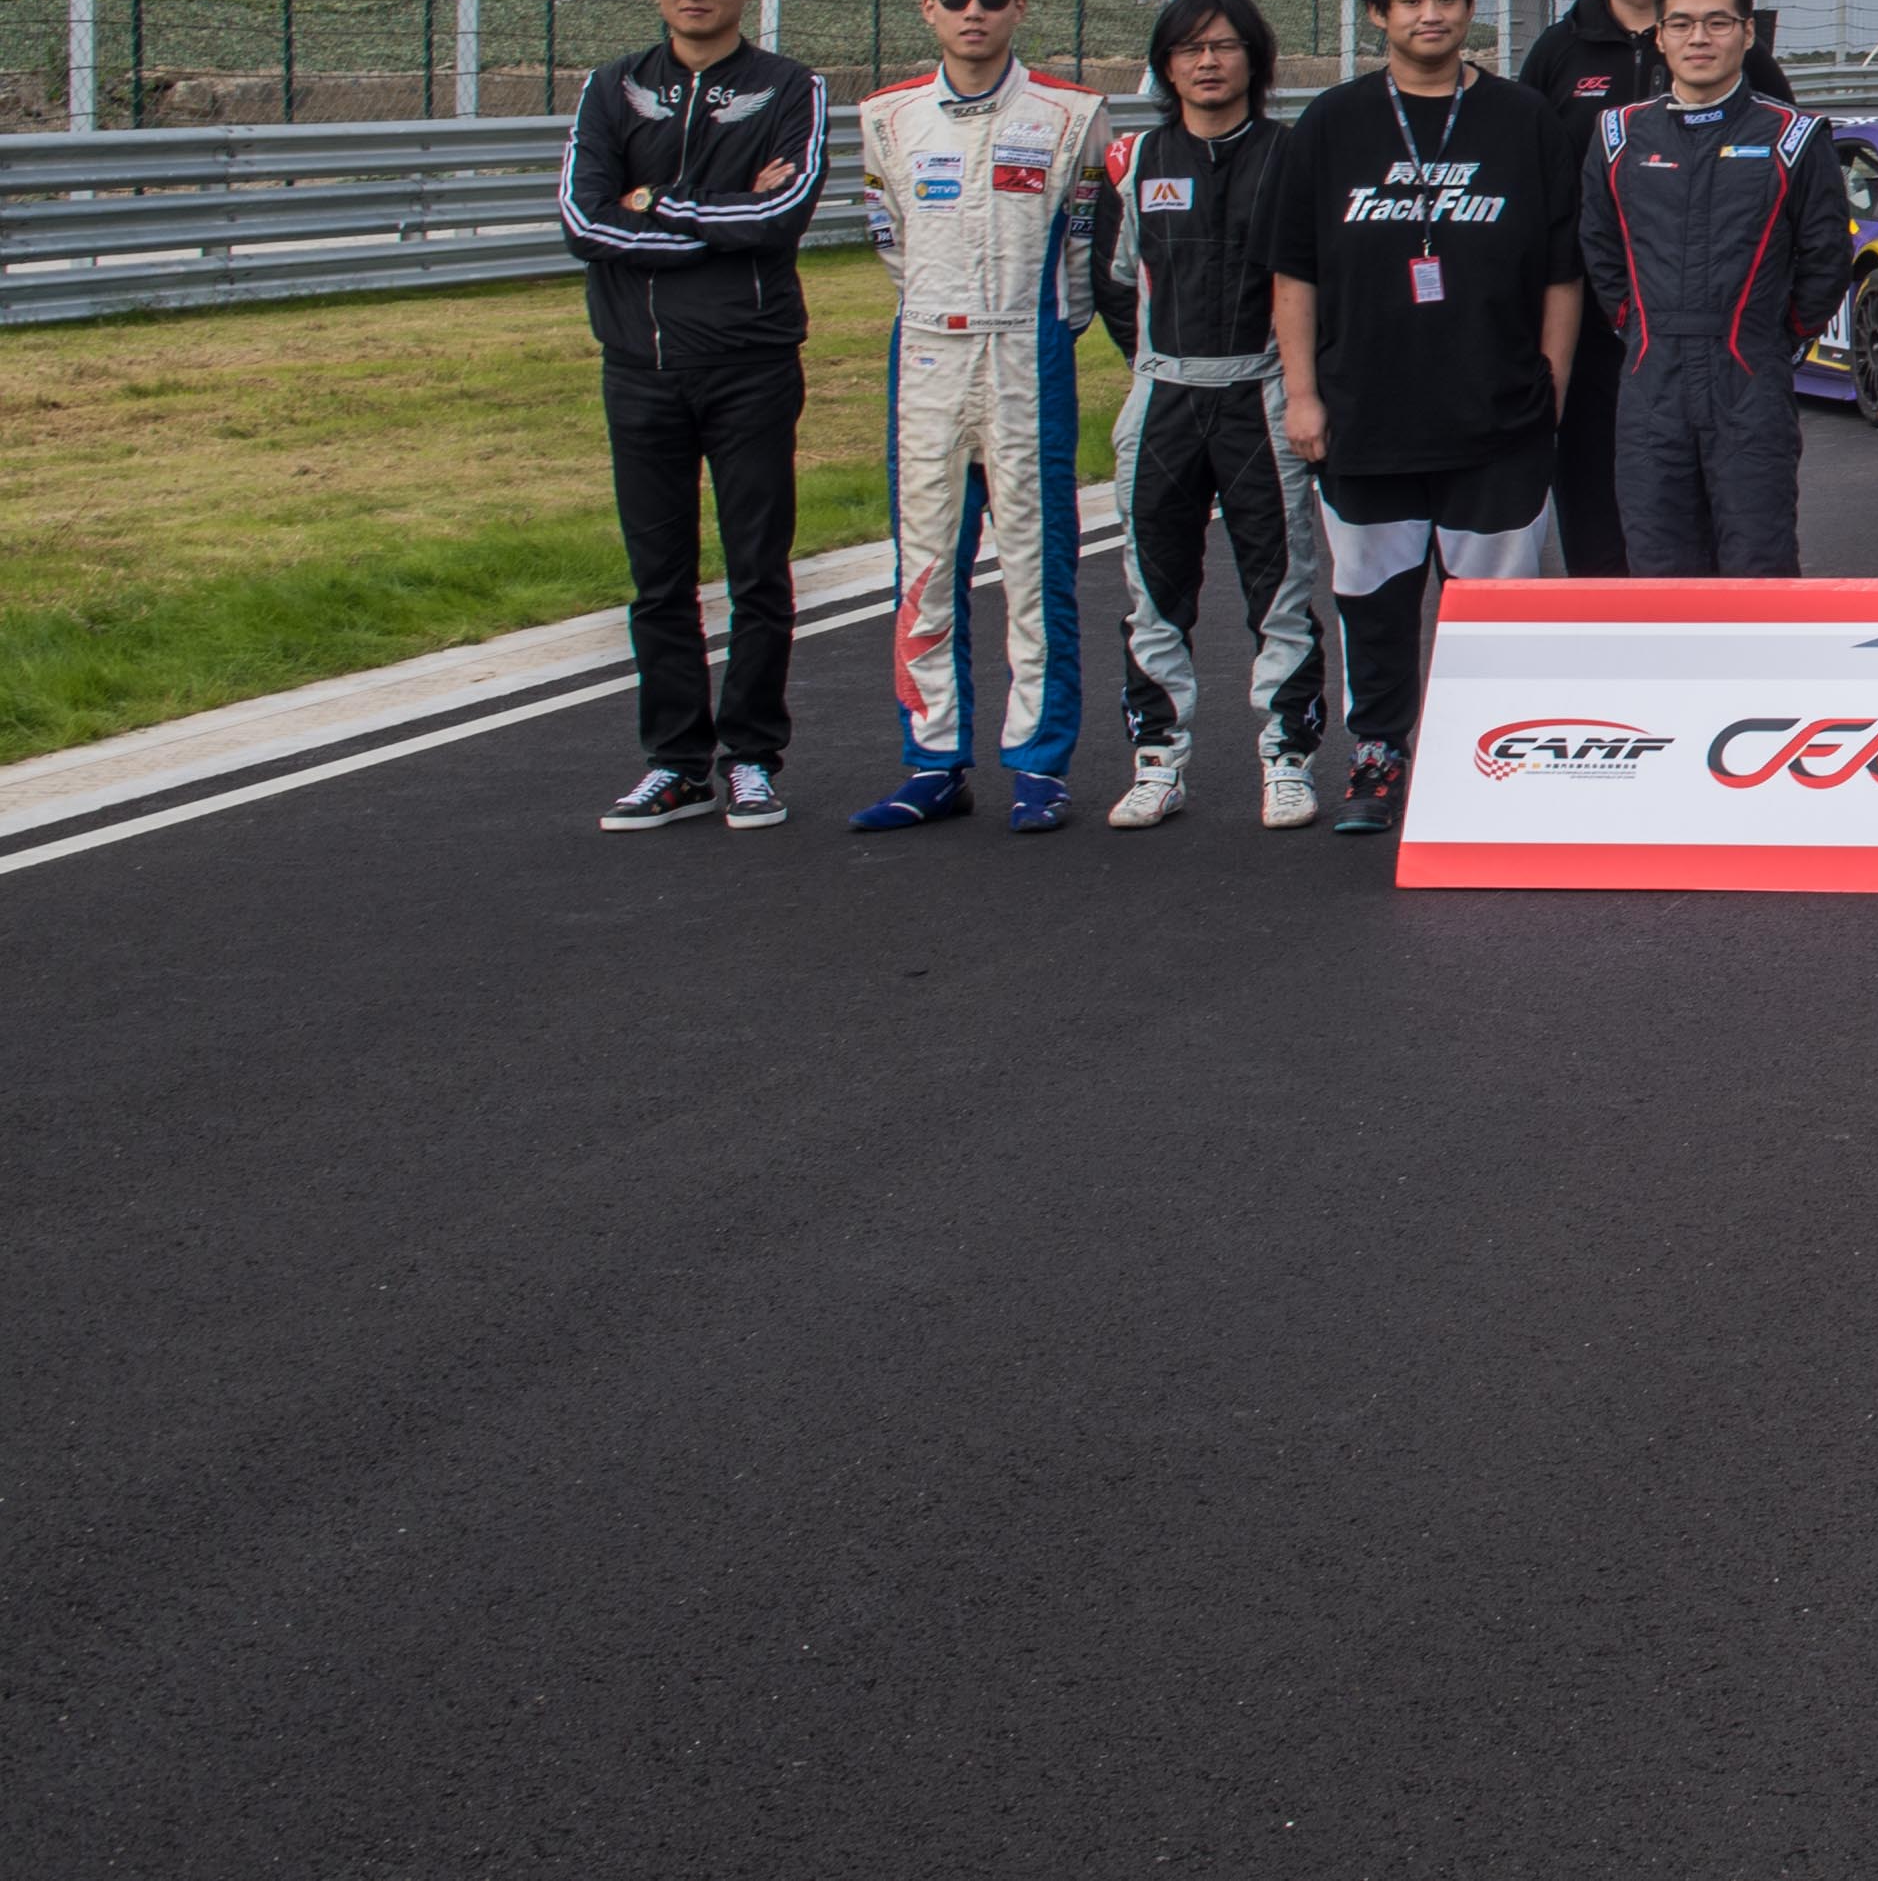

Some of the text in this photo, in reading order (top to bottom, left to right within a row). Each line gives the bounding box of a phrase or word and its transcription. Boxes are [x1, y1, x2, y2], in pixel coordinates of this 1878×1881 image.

[659, 84, 692, 103] 19
[705, 86, 735, 105] 86
[1683, 110, 1724, 125] sparco
[1345, 188, 1506, 223] Track Fun
[1494, 738, 1675, 759] CAMF
